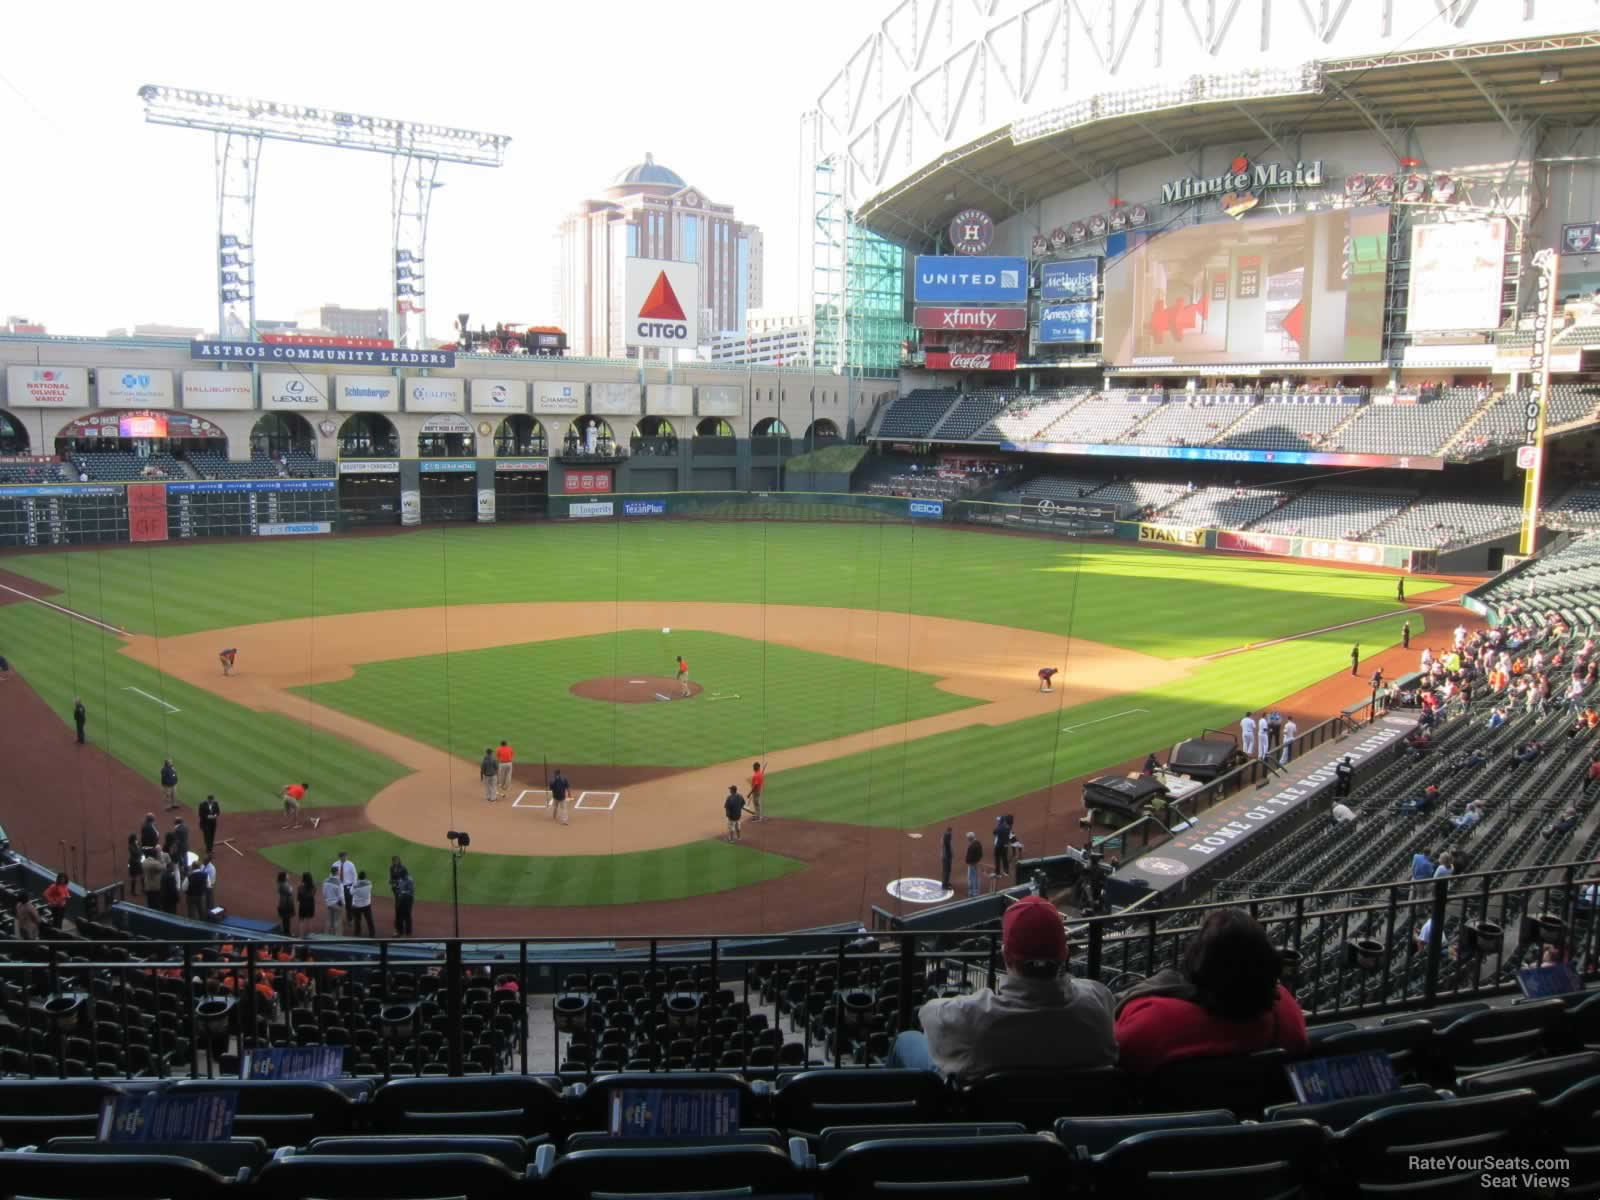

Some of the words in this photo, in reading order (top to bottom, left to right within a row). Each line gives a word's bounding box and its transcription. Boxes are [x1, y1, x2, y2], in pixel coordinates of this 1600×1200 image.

[1160, 172, 1249, 205] Minute
[1254, 161, 1322, 187] Maid
[963, 224, 980, 240] H
[922, 273, 997, 285] UNITED
[943, 309, 997, 328] xfinity
[637, 322, 688, 340] CITGO
[202, 345, 265, 357] ASTROS
[273, 348, 374, 361] COMMUNITY
[381, 351, 447, 363] LEADERS
[272, 395, 319, 403] LEXUS
[344, 386, 391, 400] Schlumberger
[580, 503, 611, 515] Insperity
[625, 503, 663, 514] TexanPlus
[910, 502, 942, 514] GEICO
[1141, 527, 1203, 545] STANLEY
[1189, 821, 1253, 854] HOME
[1245, 806, 1275, 820] OF
[1266, 786, 1307, 807] THE
